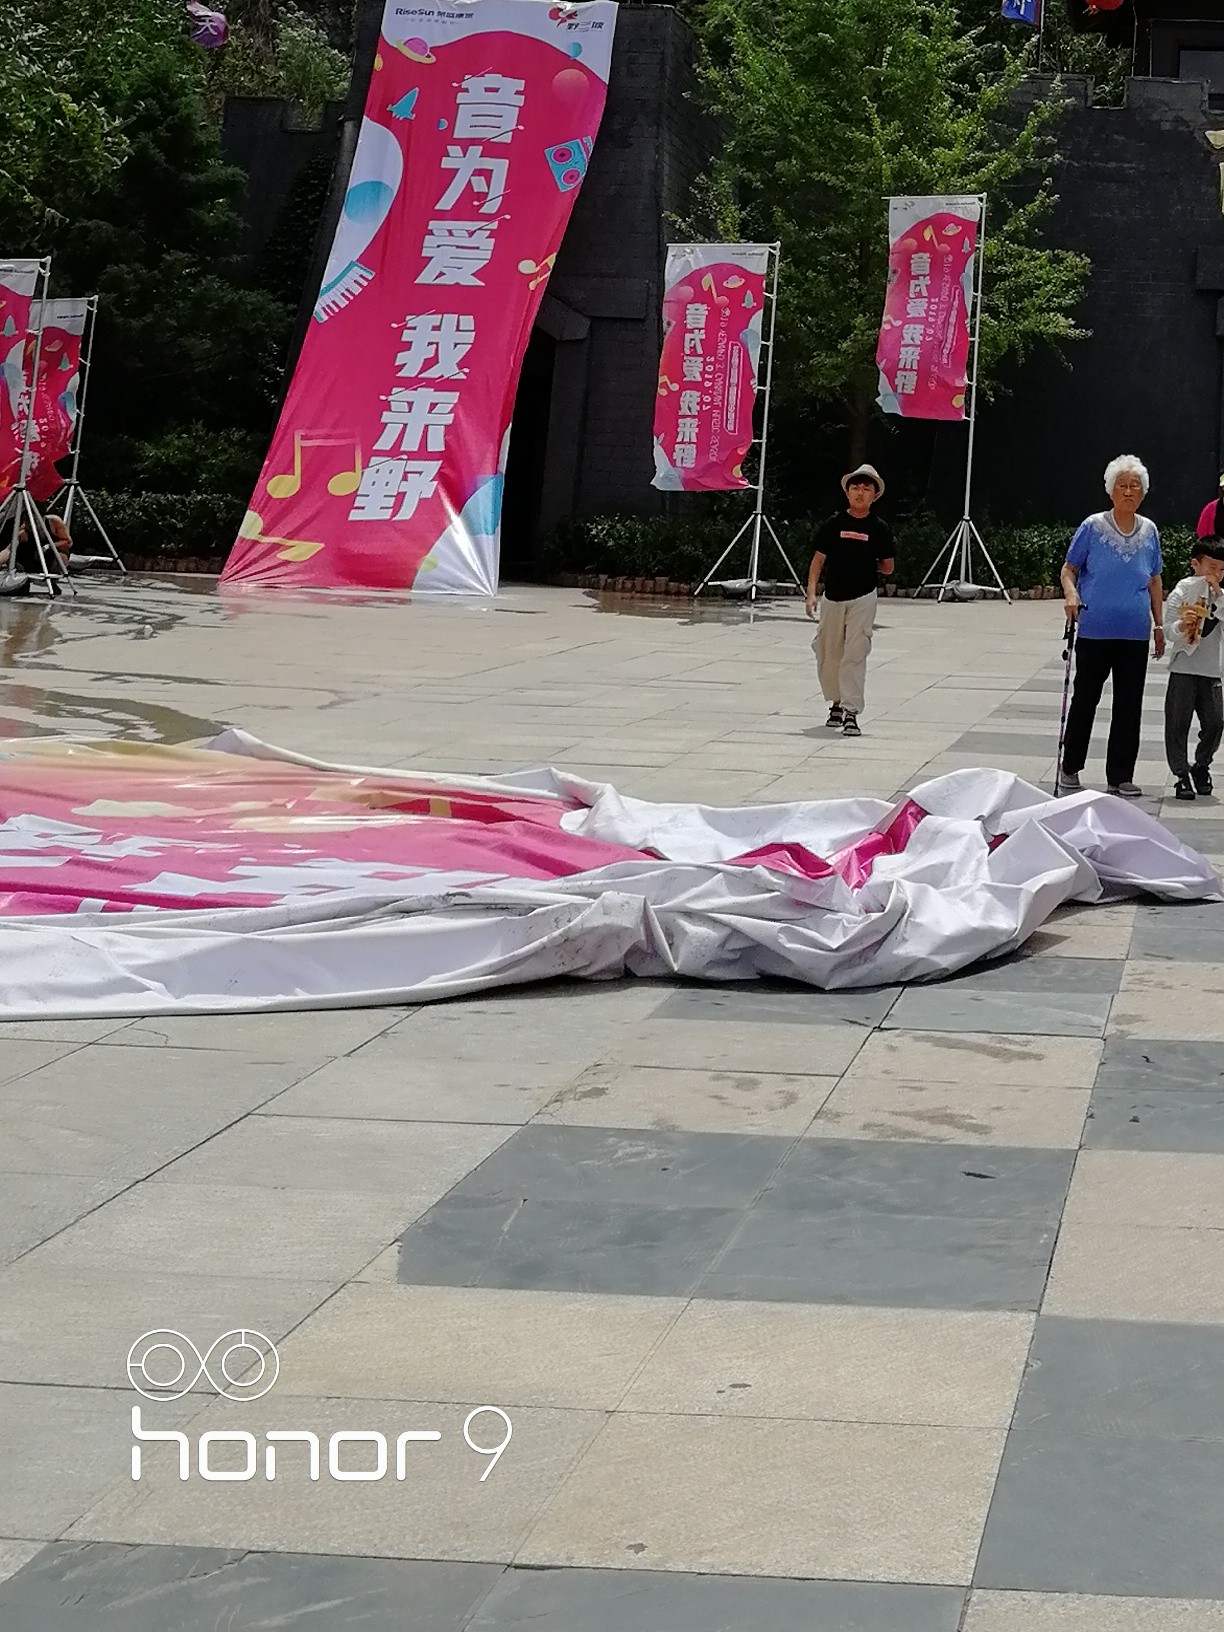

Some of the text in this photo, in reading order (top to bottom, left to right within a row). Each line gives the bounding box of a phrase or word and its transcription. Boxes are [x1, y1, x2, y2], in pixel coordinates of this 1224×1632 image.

[414, 73, 525, 286] 音为爱
[348, 313, 477, 522] 我来野
